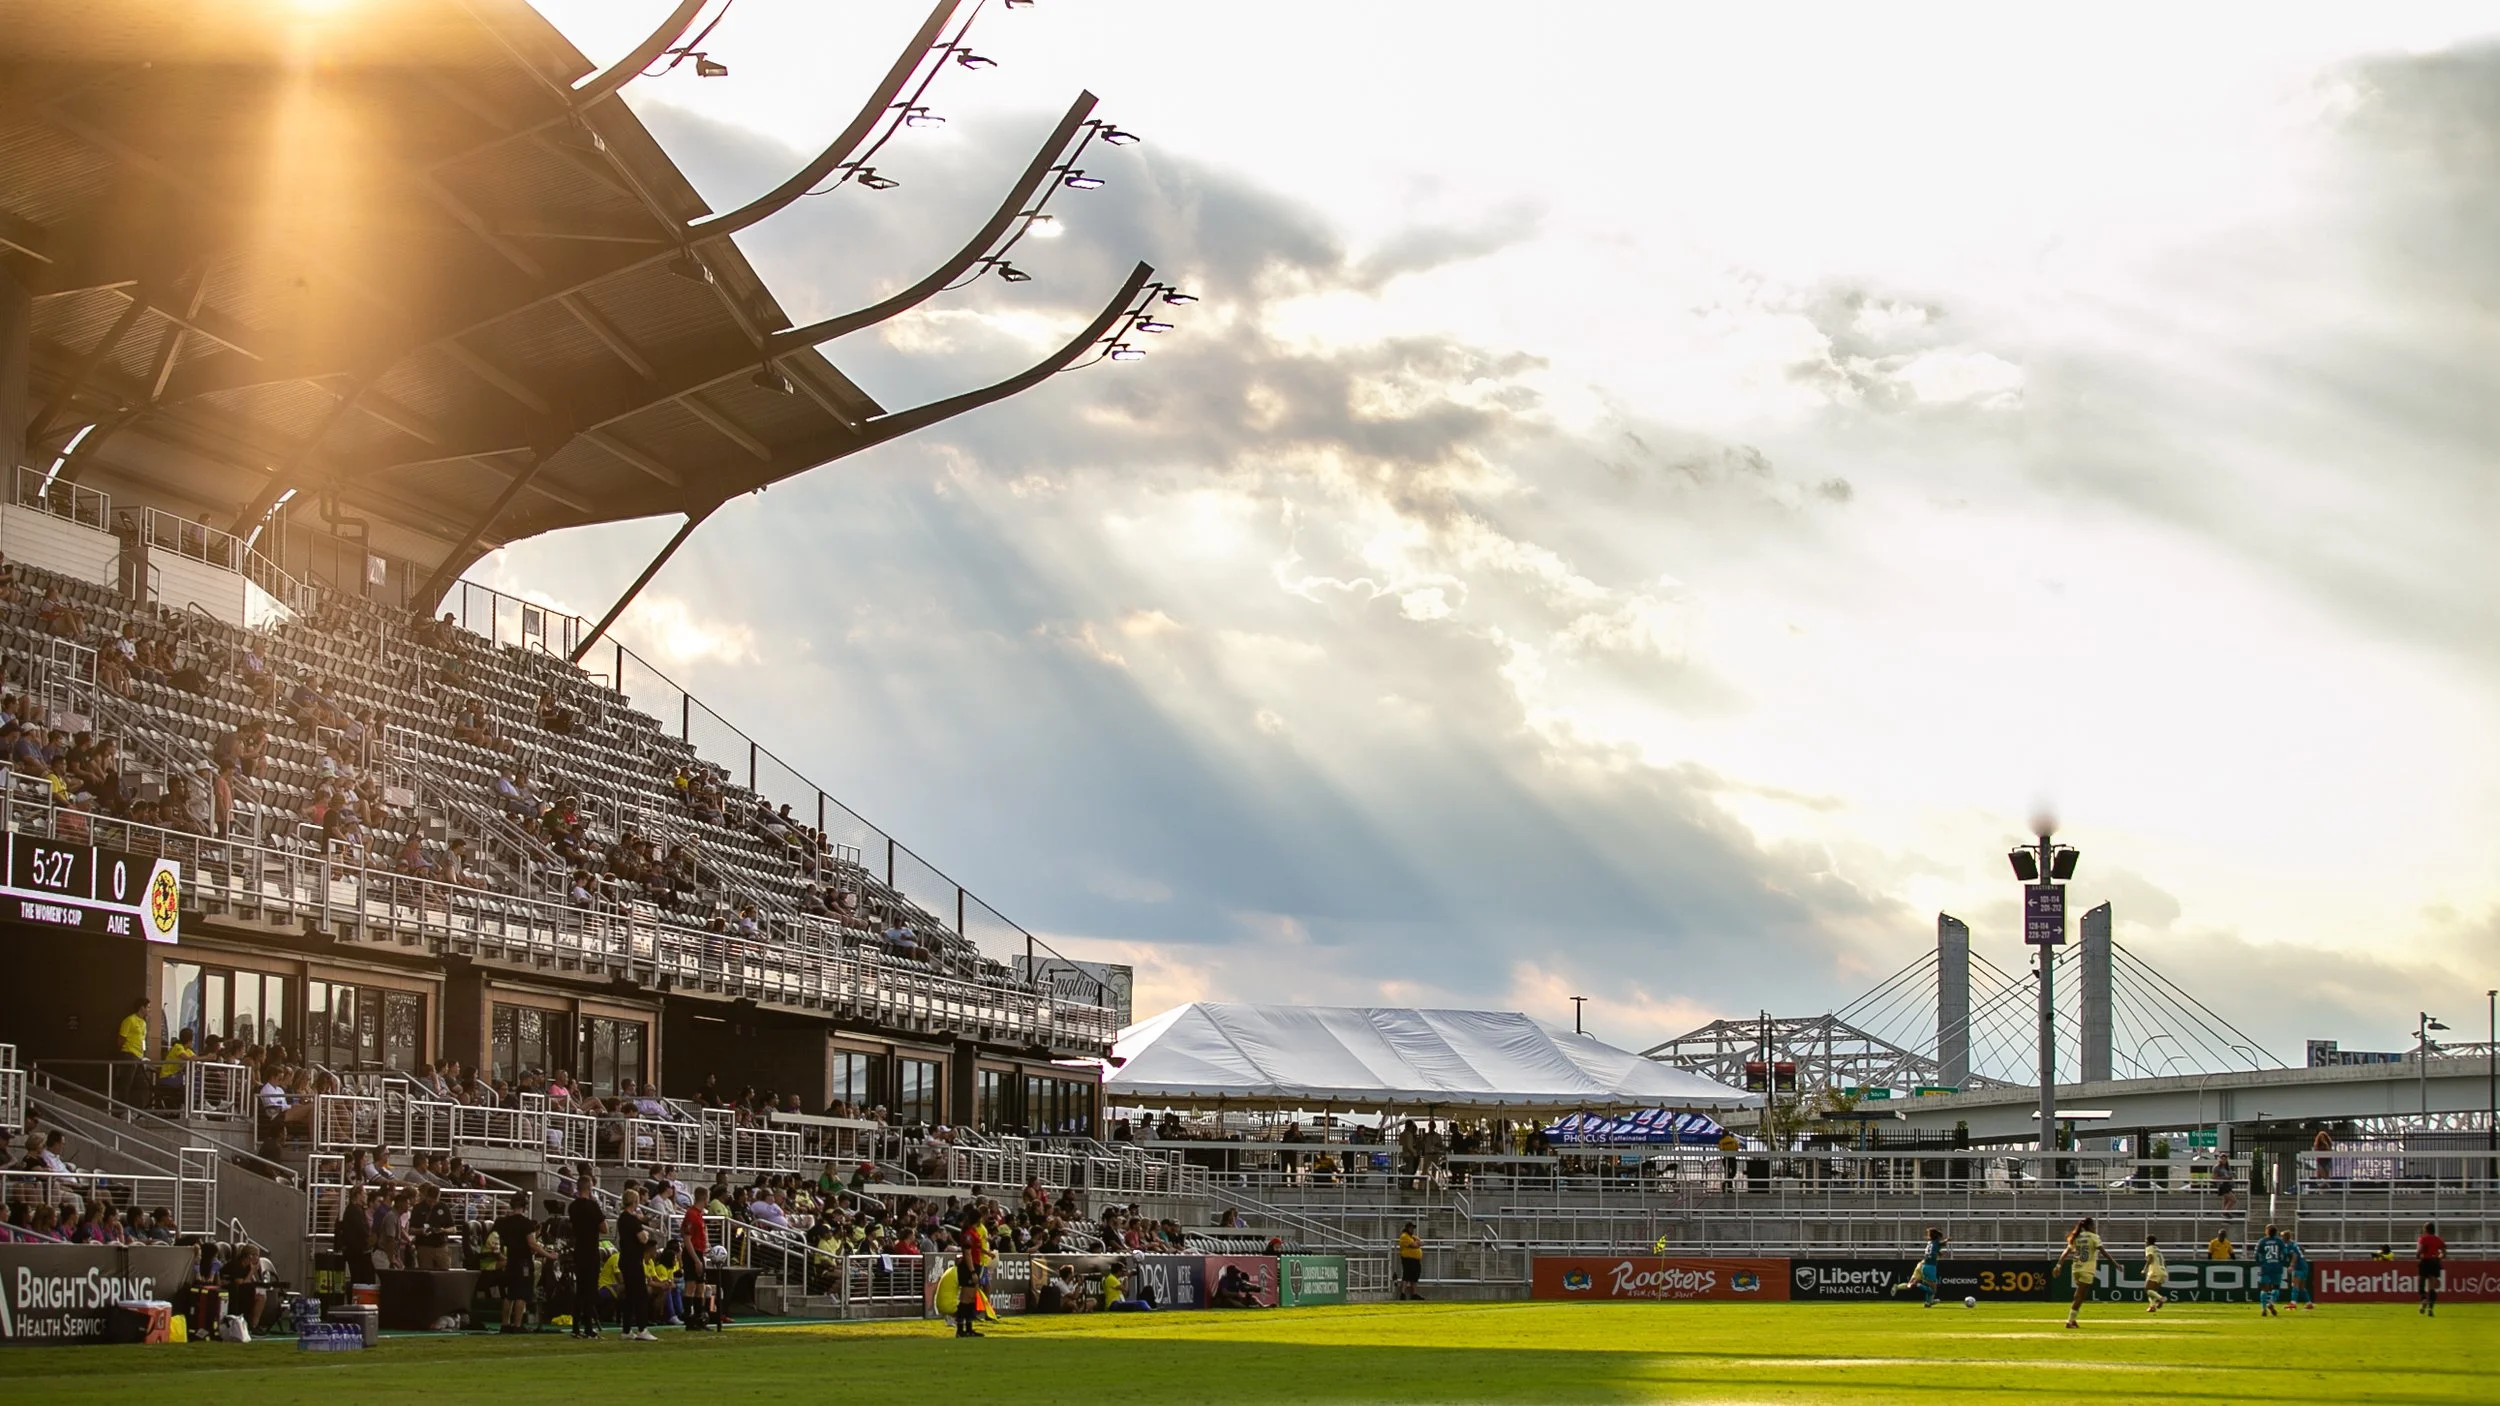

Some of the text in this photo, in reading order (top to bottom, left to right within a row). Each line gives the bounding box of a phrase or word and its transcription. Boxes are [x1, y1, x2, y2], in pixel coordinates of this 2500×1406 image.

[32, 847, 74, 889] 5:27
[113, 860, 127, 900] 0
[21, 901, 82, 926] THE WOMEN'S CUP
[107, 914, 131, 935] AME
[1563, 1133, 1606, 1143] PHOCUS
[2264, 1245, 2279, 1260] 24
[1608, 1261, 1717, 1296] Roosters
[1819, 1267, 1892, 1289] Liberty
[1942, 1277, 1978, 1285] CHECKING
[1980, 1271, 2047, 1292] 3.30%
[1819, 1285, 1880, 1295] FINANCIAL
[17, 1314, 60, 1337] HEALTH
